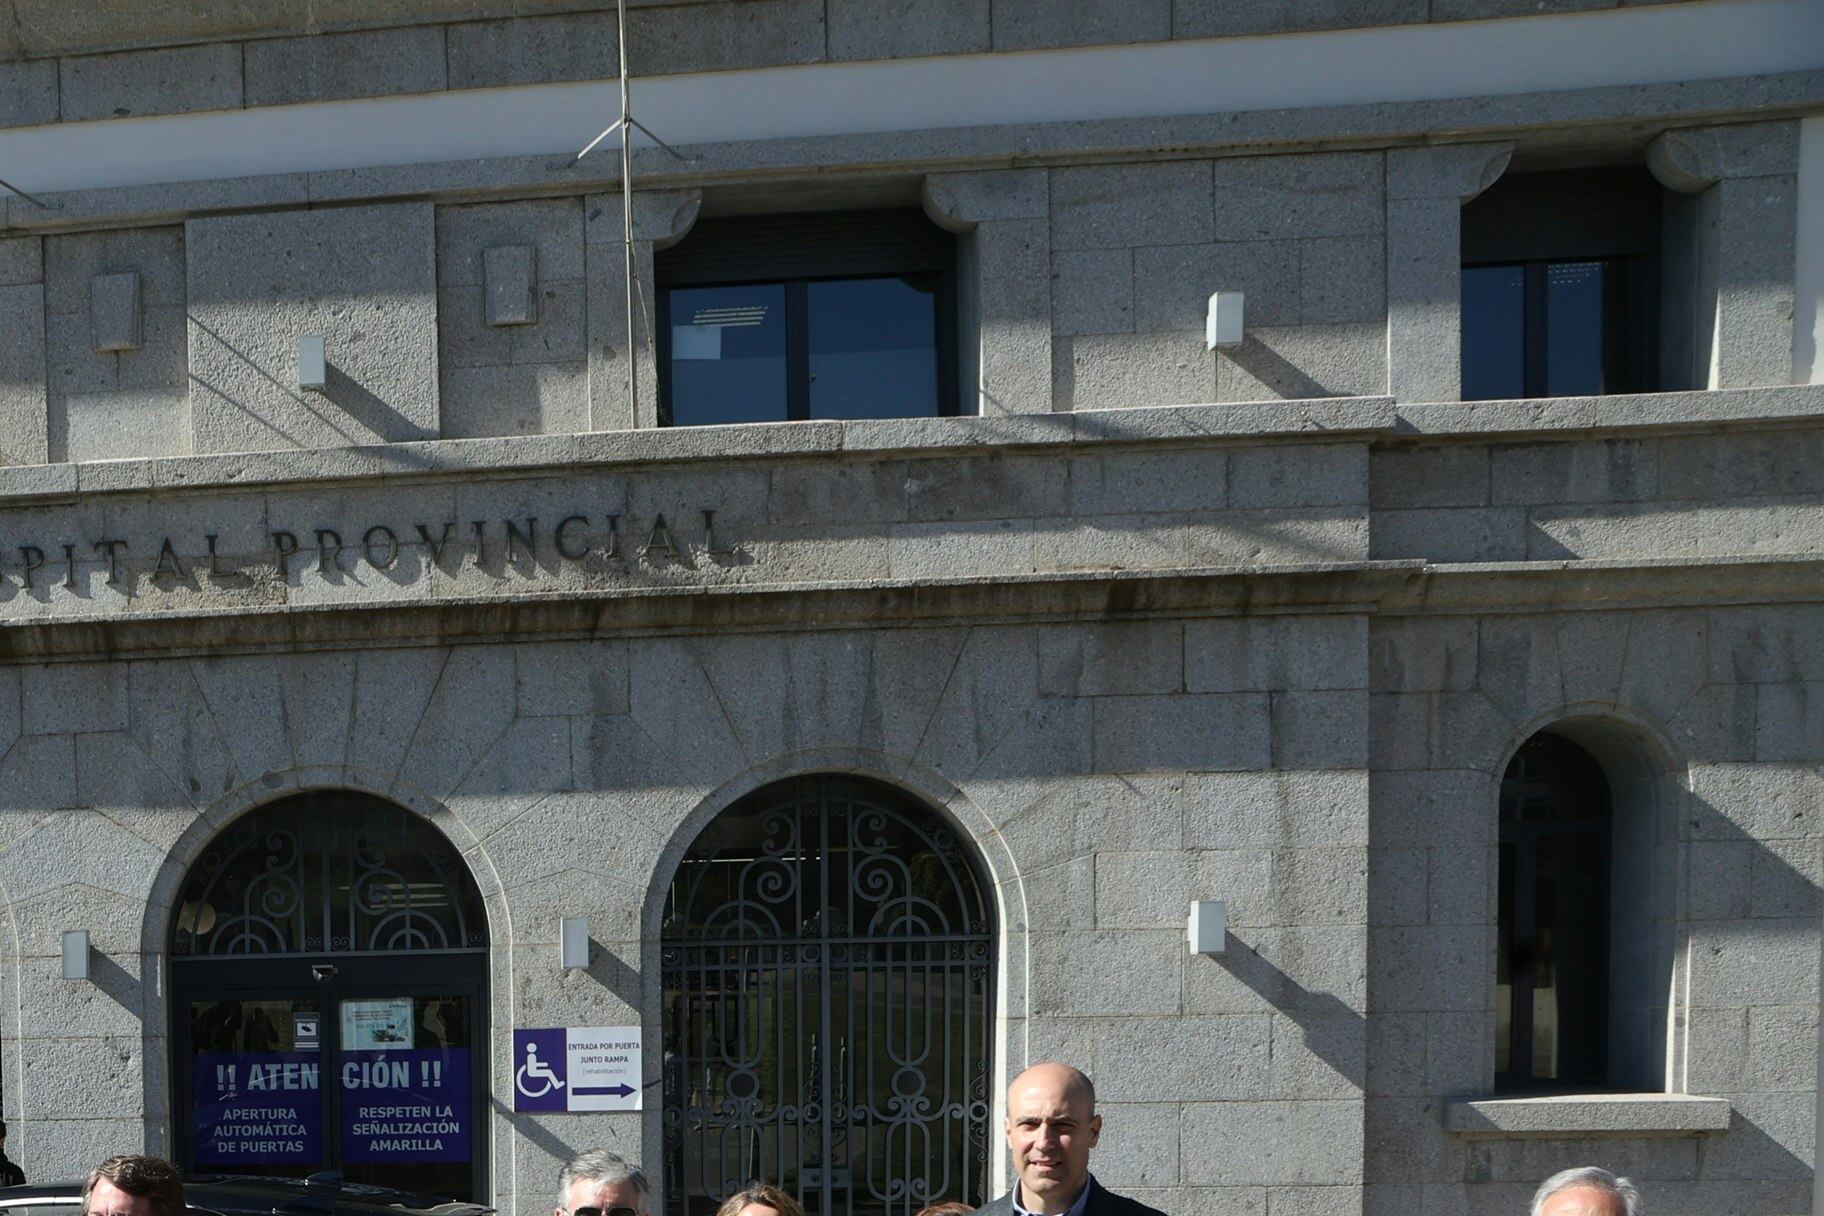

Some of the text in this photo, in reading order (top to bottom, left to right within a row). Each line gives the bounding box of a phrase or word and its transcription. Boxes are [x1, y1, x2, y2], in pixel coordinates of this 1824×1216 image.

[271, 509, 733, 576] PROVINCIAL
[568, 1042, 640, 1051] ENTRADA POR PUERTA
[580, 1055, 629, 1064] JUNTO RAMPA
[247, 1063, 319, 1090] ATEN
[342, 1055, 410, 1089] CIÓN
[582, 1067, 627, 1075] (rehabilitación)
[223, 1108, 297, 1120] APERTURA
[359, 1105, 453, 1118] RESPETEN LA
[214, 1121, 307, 1136] AUTOMÁTICA
[352, 1118, 460, 1135] SEÑALIZACIÓN
[218, 1140, 304, 1153] DE PUERTAS
[369, 1139, 443, 1151] AMARILLA
